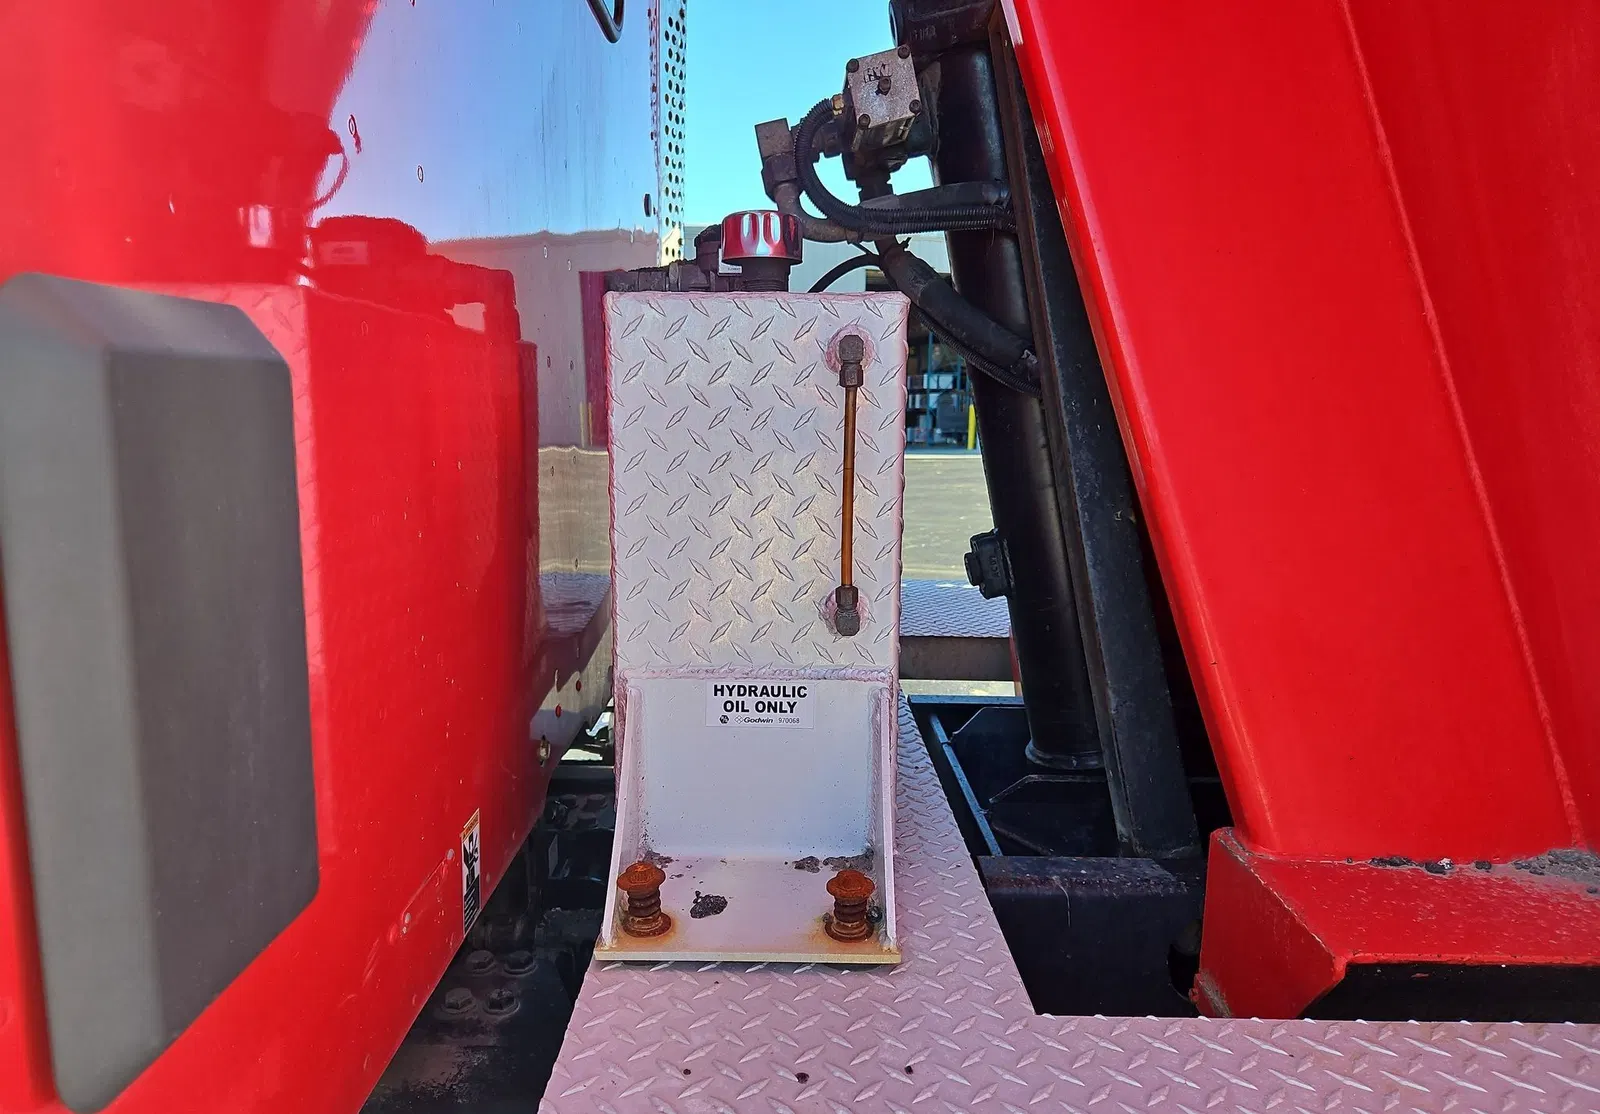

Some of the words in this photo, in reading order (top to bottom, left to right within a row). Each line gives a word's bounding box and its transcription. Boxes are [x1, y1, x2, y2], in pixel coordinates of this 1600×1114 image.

[713, 684, 808, 698] HYDRAULIC
[723, 700, 750, 713] OIL
[755, 701, 798, 713] ONLY
[743, 716, 774, 724] Godwin
